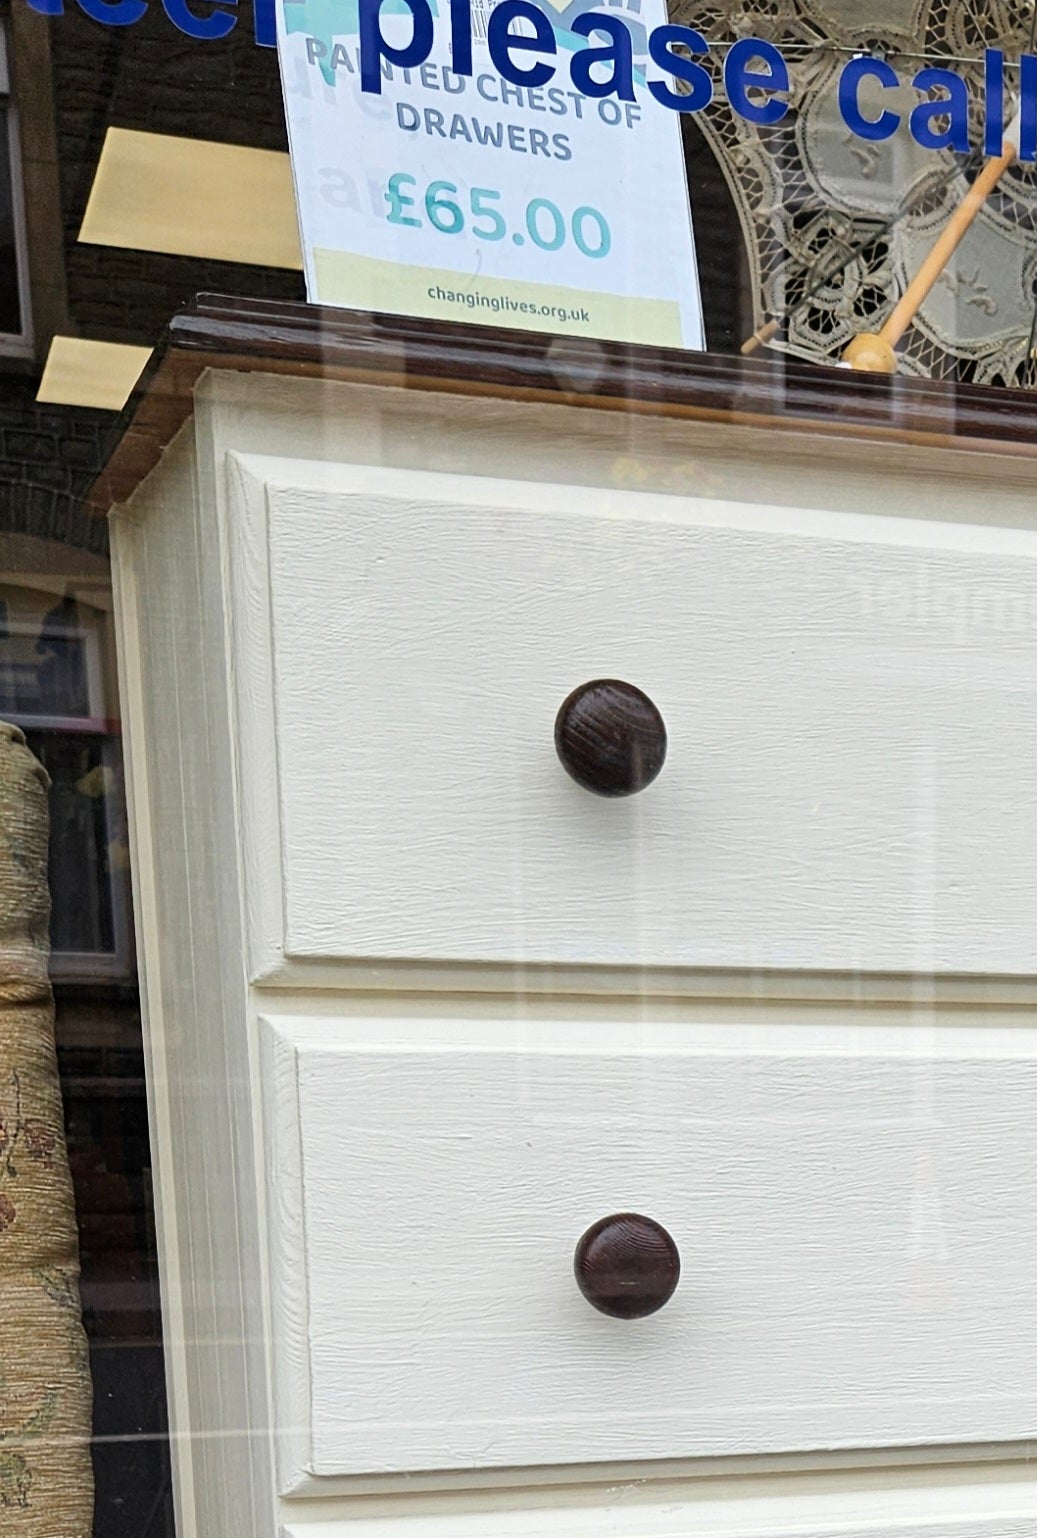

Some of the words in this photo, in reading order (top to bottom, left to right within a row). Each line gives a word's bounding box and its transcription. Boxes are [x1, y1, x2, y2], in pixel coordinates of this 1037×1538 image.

[306, 37, 466, 94] PATED
[477, 73, 587, 120] CHEST
[598, 98, 642, 129] OF
[358, 0, 790, 125] please
[396, 102, 573, 161] DRAWERS
[384, 172, 612, 259] £65.00
[427, 285, 590, 322] changinglives.org.uk
